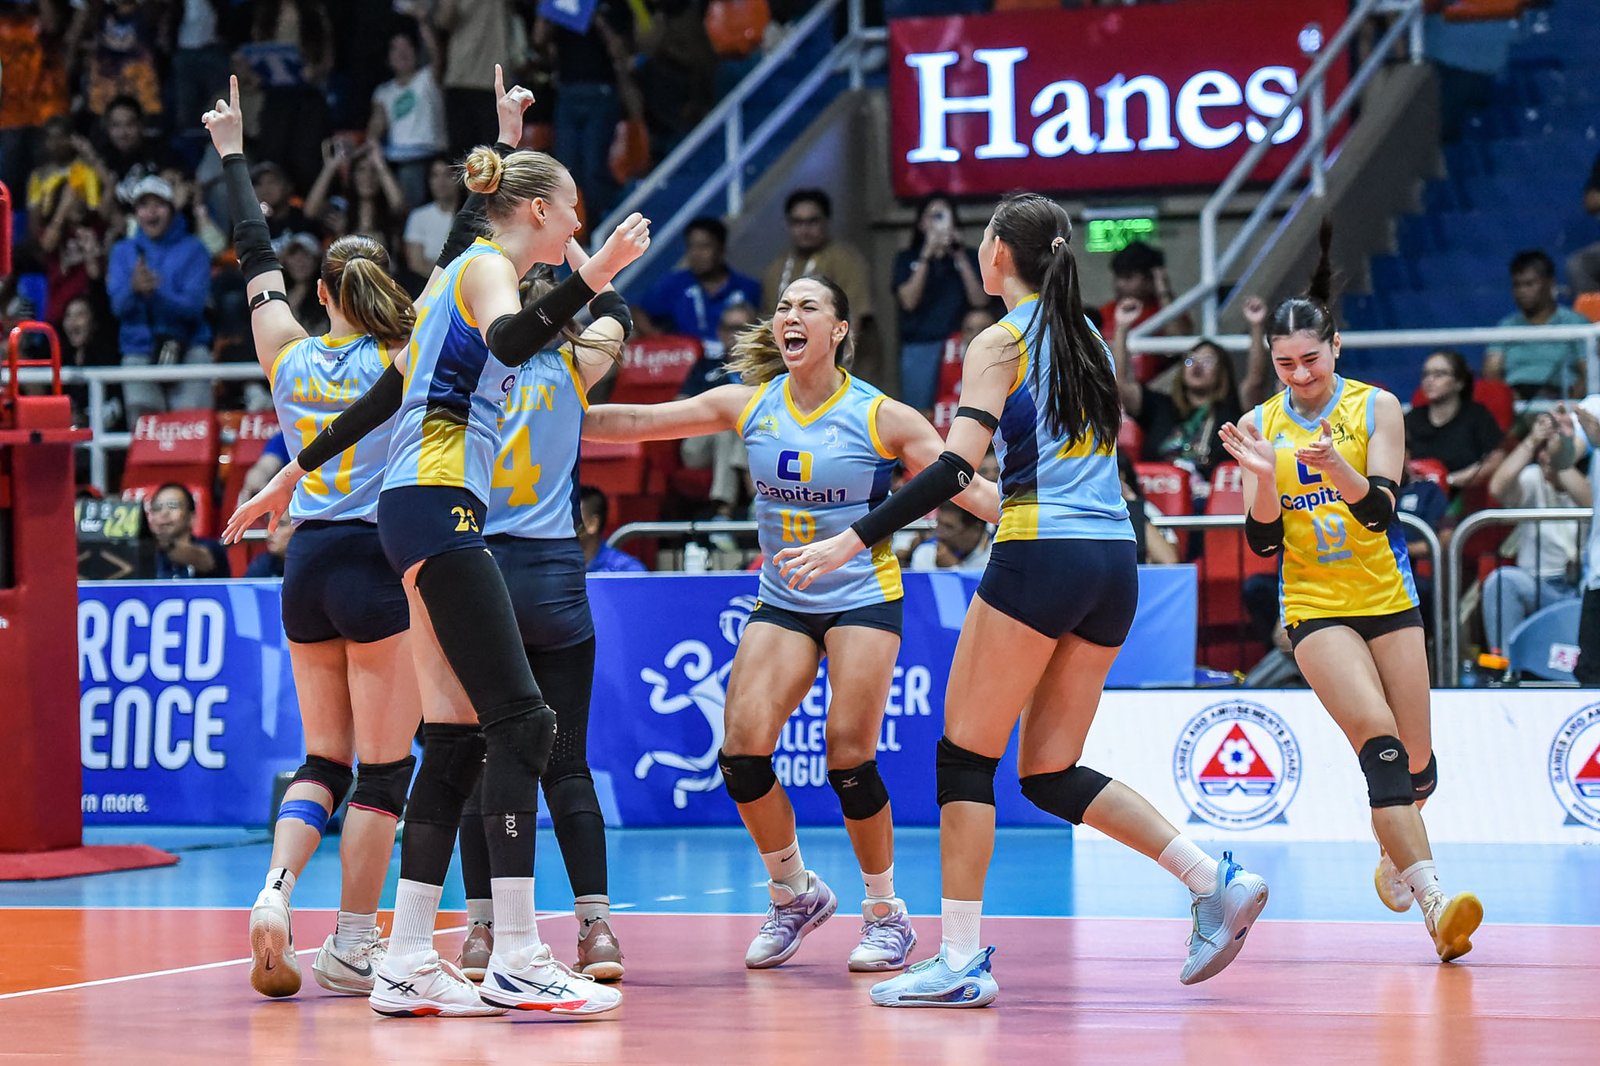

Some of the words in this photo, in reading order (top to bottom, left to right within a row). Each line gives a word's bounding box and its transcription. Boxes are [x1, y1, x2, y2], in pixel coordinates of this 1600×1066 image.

[904, 46, 1304, 164] Hanes
[504, 384, 556, 414] LEN
[134, 415, 208, 441] Hanes
[295, 413, 357, 495] 17
[755, 480, 847, 503] Capital1
[780, 508, 816, 544] 10
[1312, 513, 1346, 552] 19
[78, 598, 226, 683] RCED
[80, 685, 229, 770] ENCE
[81, 794, 99, 813] rn
[102, 793, 150, 813] more.
